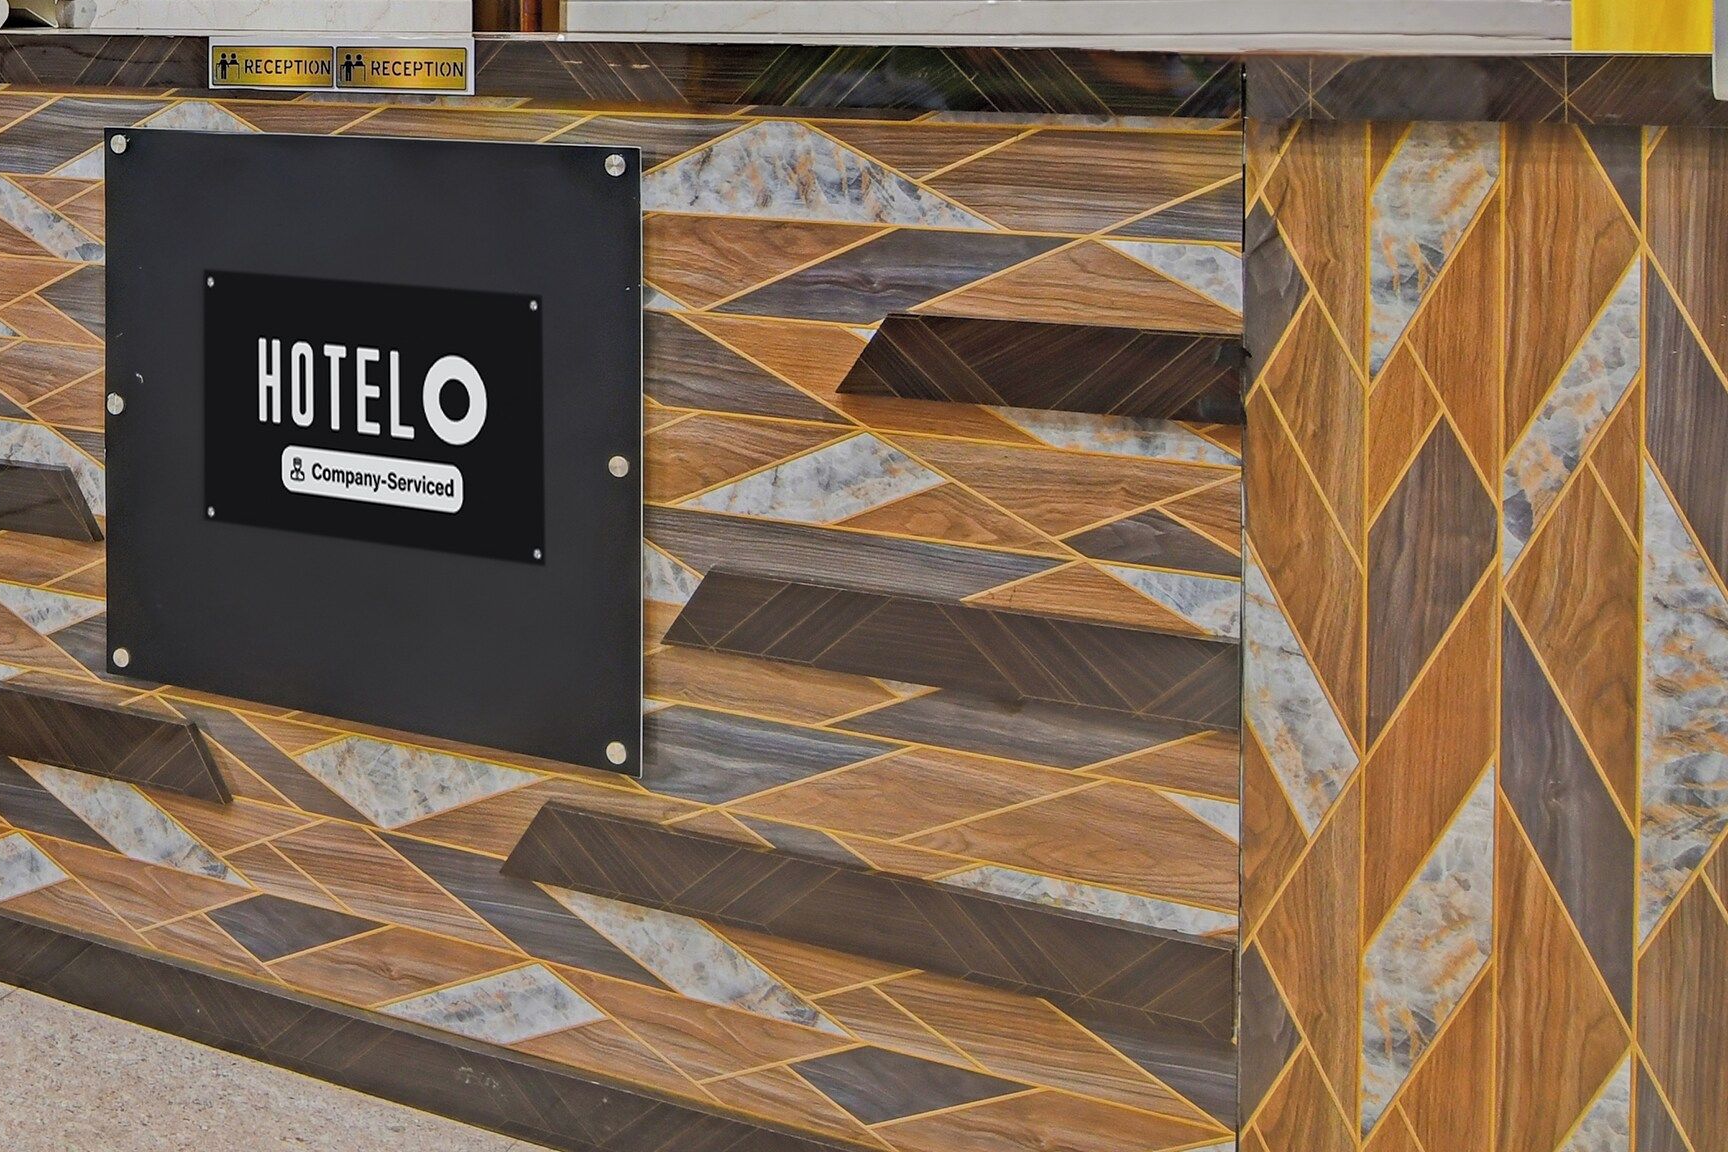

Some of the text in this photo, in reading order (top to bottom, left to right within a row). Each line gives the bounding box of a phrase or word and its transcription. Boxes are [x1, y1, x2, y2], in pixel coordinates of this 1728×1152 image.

[244, 58, 332, 76] RECEPTION
[371, 60, 465, 78] RECEPTION
[258, 337, 415, 440] HOTEL
[311, 462, 455, 498] Company-Serviced
